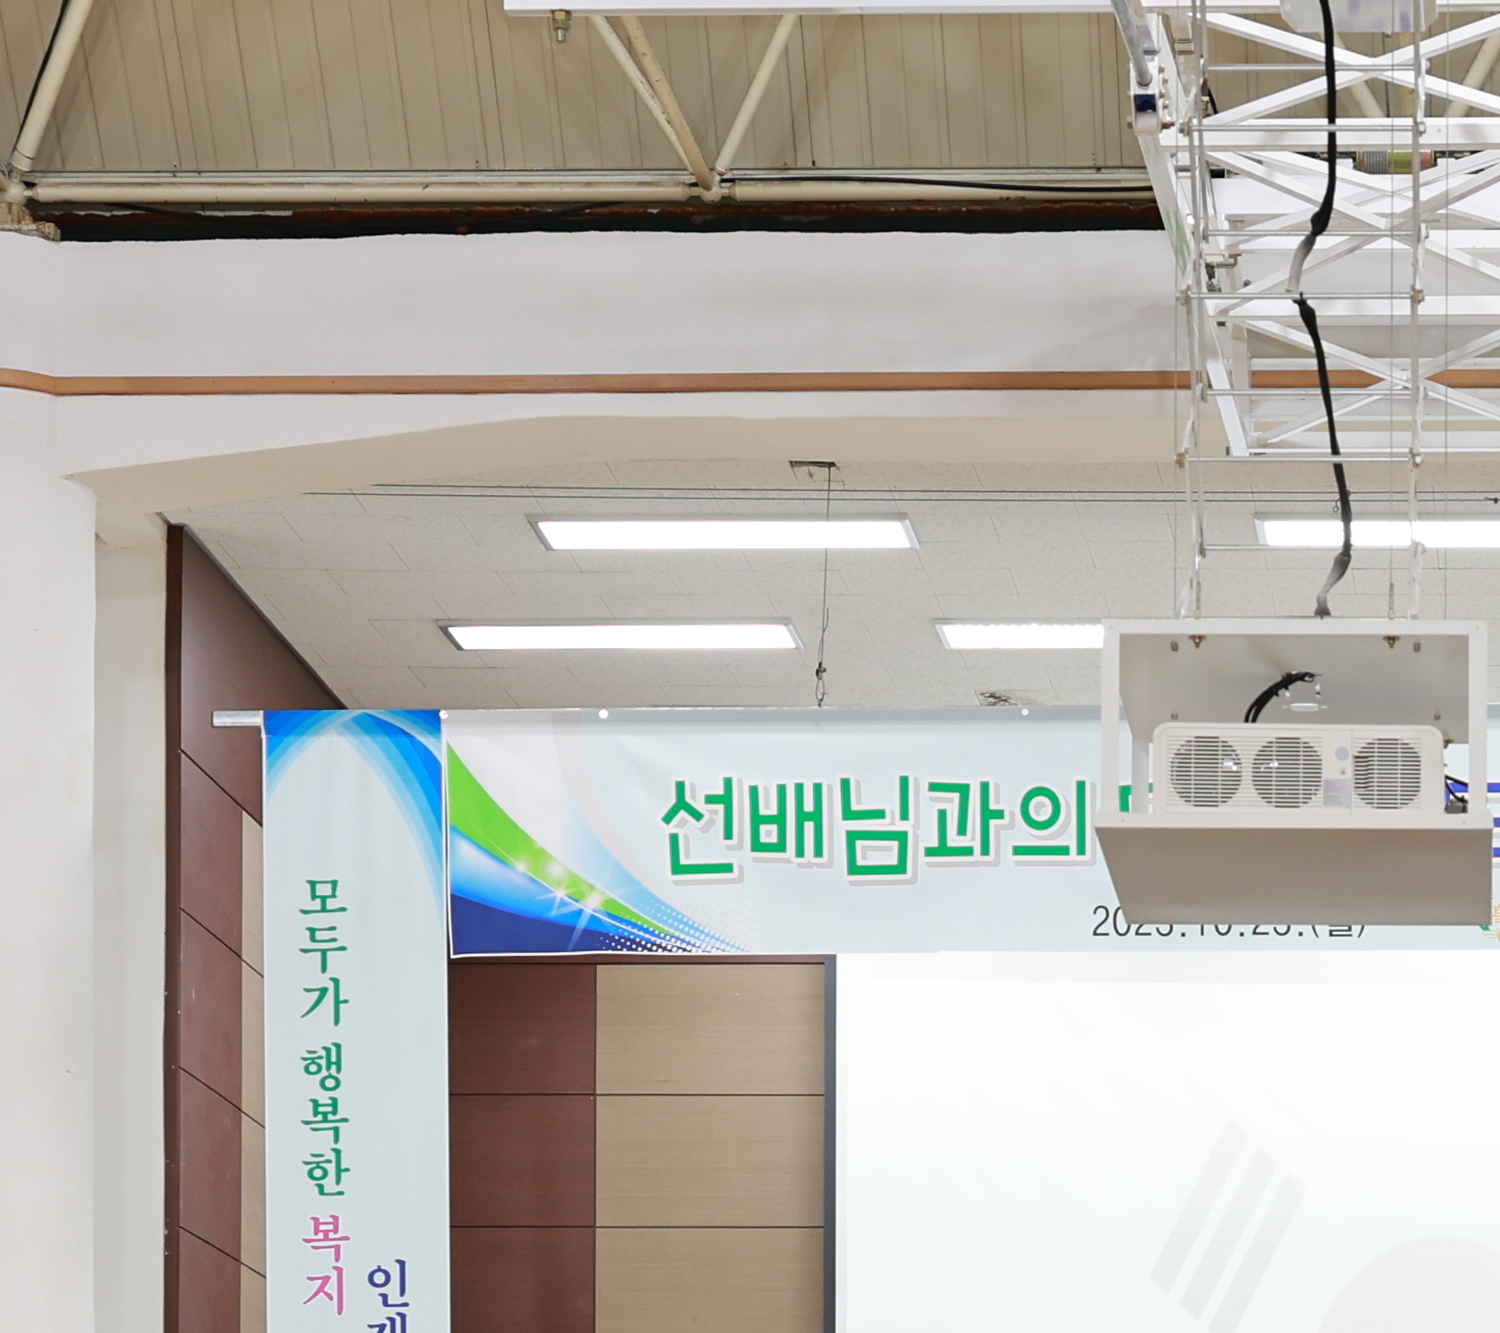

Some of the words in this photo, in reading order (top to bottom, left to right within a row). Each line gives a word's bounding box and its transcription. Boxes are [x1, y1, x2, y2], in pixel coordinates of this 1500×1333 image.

[660, 774, 1088, 877] 선배님과의
[298, 878, 349, 1027] 모두가
[299, 1041, 351, 1197] 행복한
[301, 1213, 351, 1316] 복지
